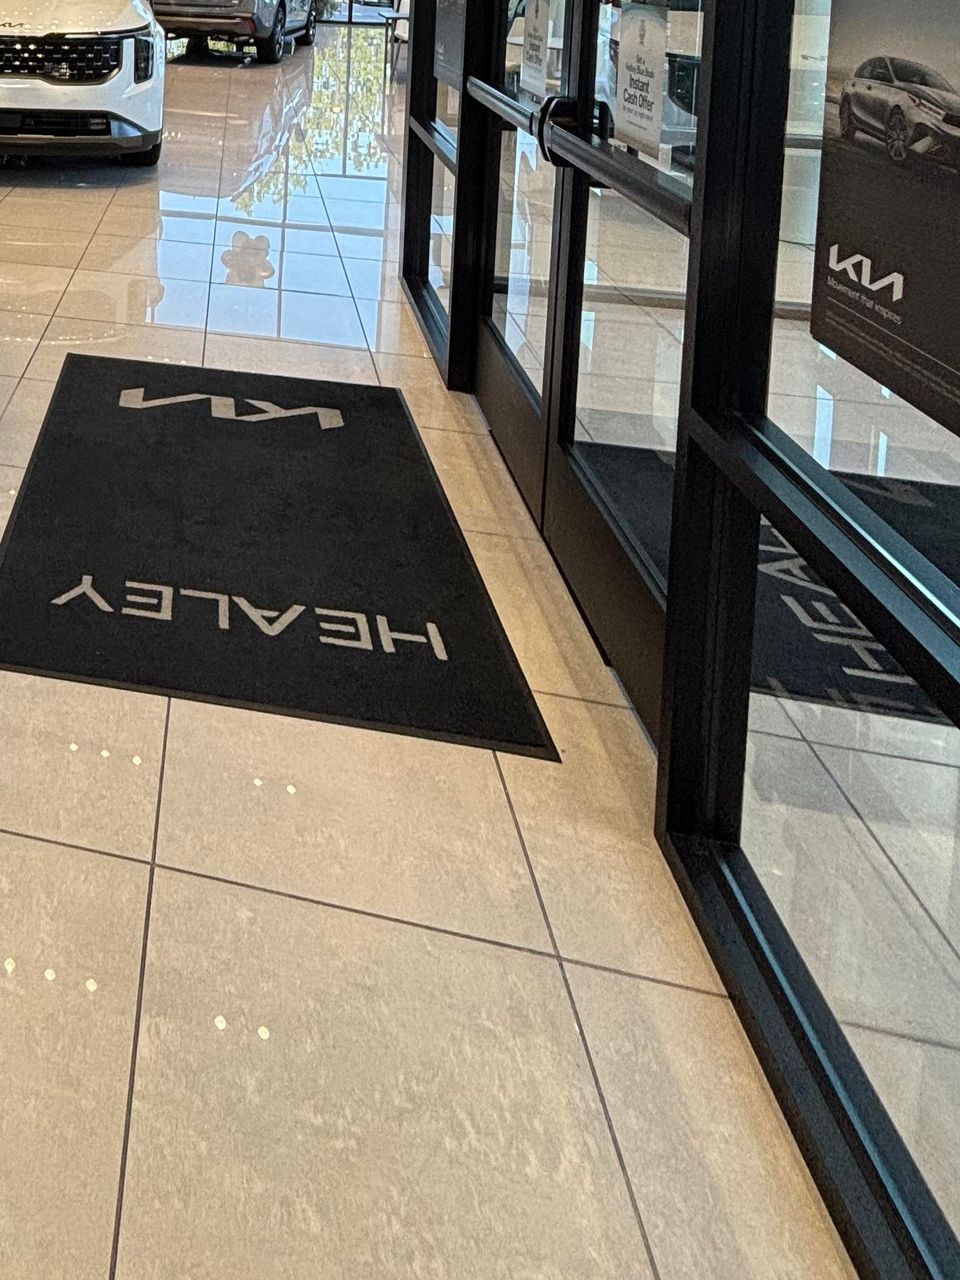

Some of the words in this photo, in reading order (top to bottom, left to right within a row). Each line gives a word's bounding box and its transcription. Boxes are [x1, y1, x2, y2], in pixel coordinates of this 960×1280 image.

[623, 88, 638, 106] Cash
[638, 94, 654, 111] Offer
[629, 74, 650, 94] Instant
[828, 243, 904, 302] KIA
[827, 275, 860, 301] Movement
[860, 293, 874, 309] that
[874, 303, 902, 325] inspires
[119, 386, 344, 431] KIA
[50, 574, 448, 661] HEALEY
